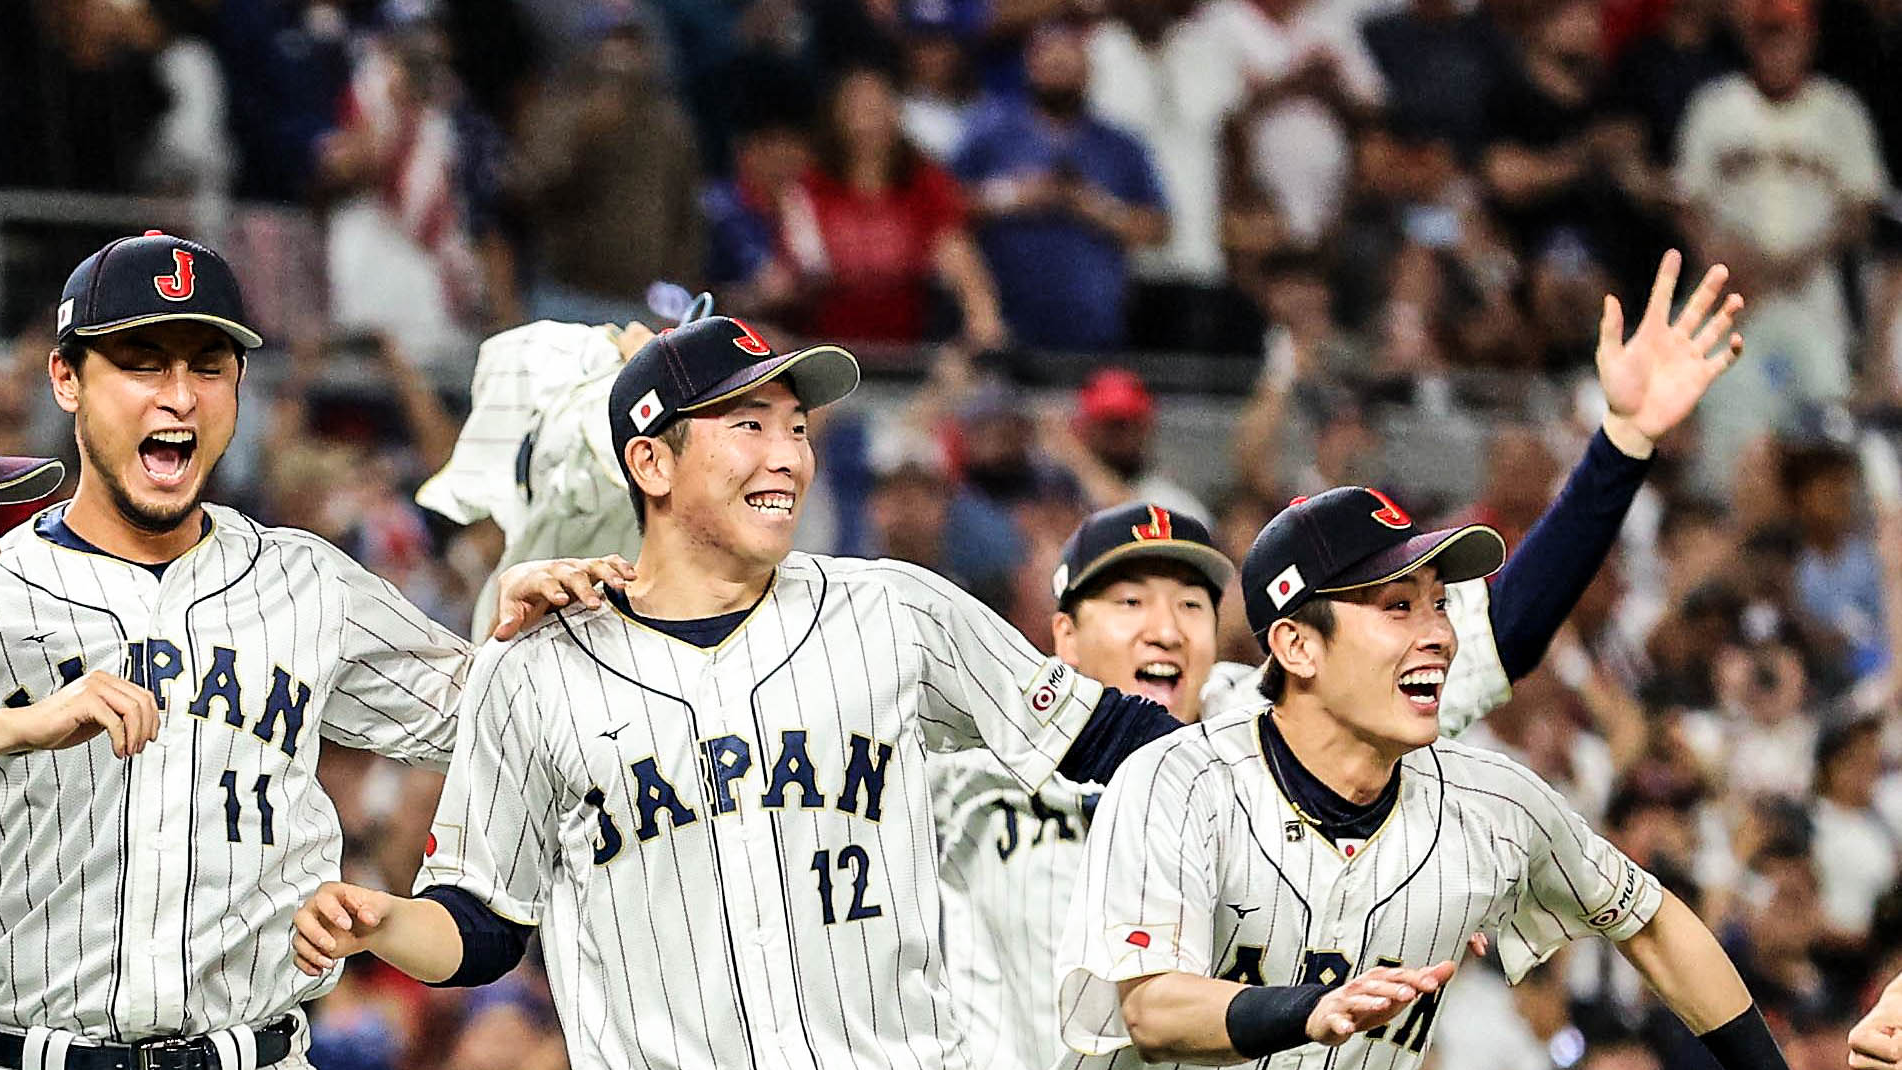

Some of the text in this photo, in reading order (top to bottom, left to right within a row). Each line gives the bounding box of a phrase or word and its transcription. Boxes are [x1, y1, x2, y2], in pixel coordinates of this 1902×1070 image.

[153, 248, 196, 302] J
[1131, 503, 1172, 542] J
[2, 635, 313, 765] PAN
[1047, 663, 1067, 690] MU
[218, 767, 275, 847] 11
[580, 727, 894, 868] JAPAN
[809, 843, 885, 927] 12
